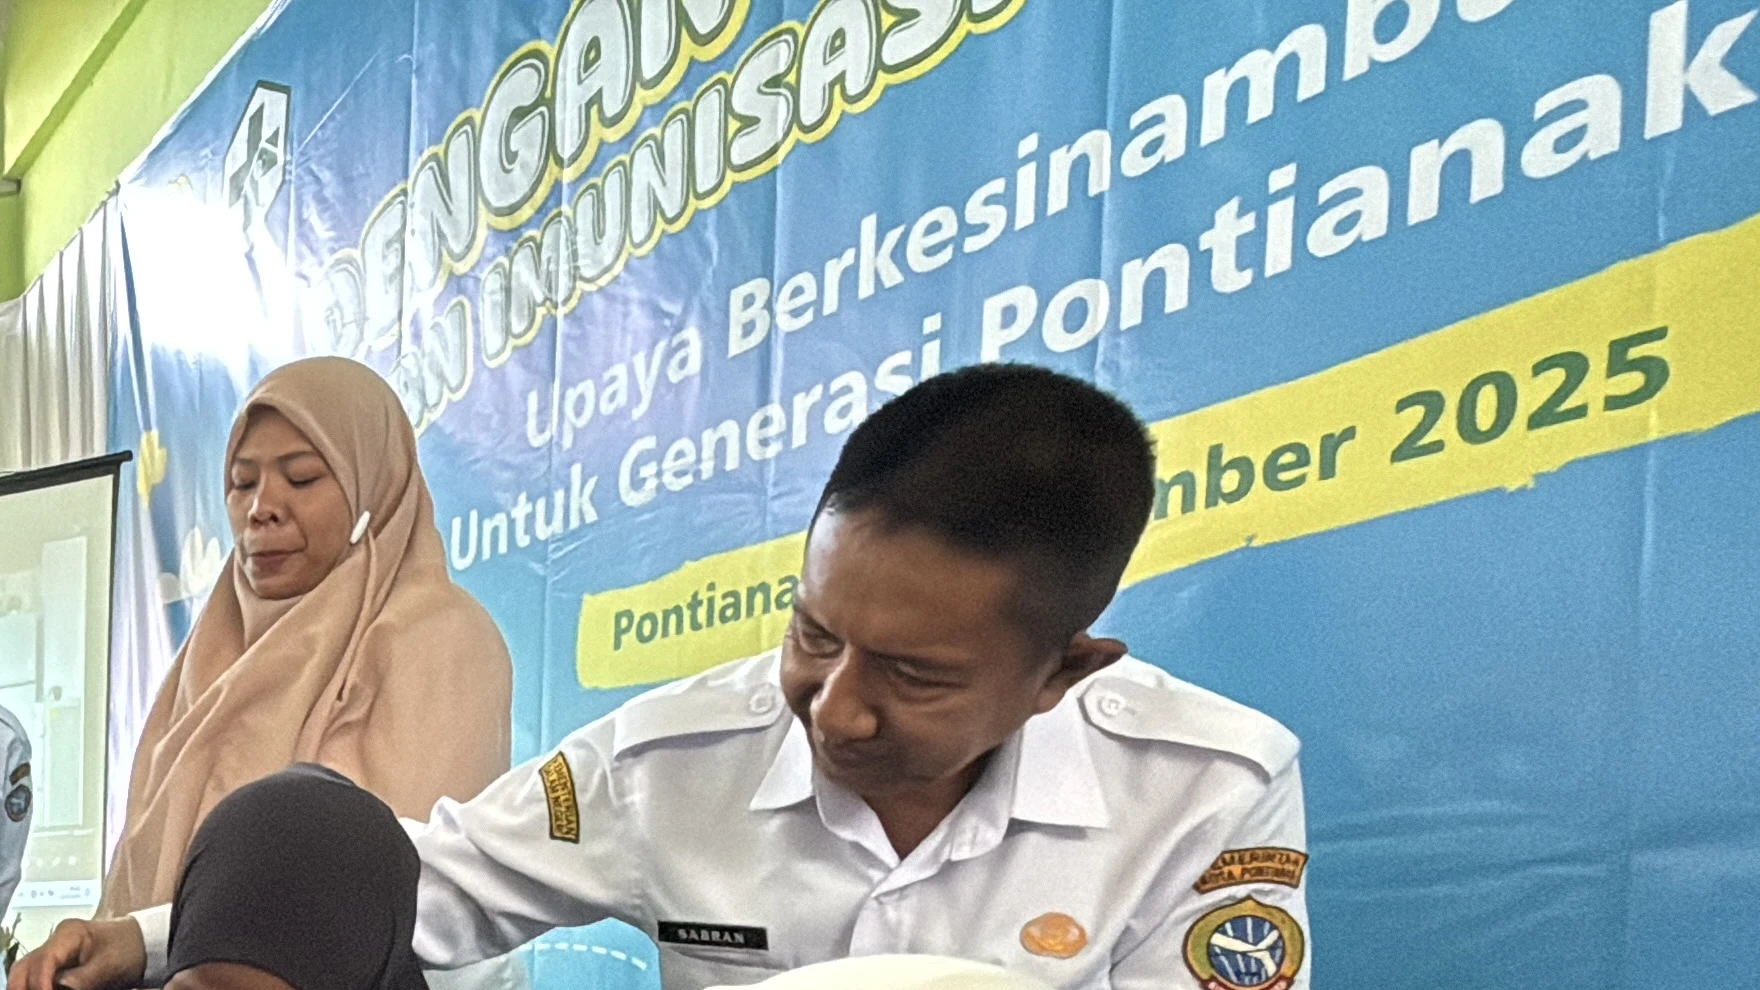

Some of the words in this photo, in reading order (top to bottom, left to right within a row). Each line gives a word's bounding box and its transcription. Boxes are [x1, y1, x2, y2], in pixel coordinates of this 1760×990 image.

[449, 466, 599, 571] Untuk
[618, 320, 942, 508] Generasi
[980, 0, 1760, 363] Pontianak
[480, 0, 1026, 370] IMUNISAS
[526, 325, 703, 450] Upaya
[726, 0, 1515, 359] Berkesinamb
[613, 573, 799, 651] Pontiana
[1390, 326, 1670, 464] 2025
[677, 928, 745, 944] SABRAN
